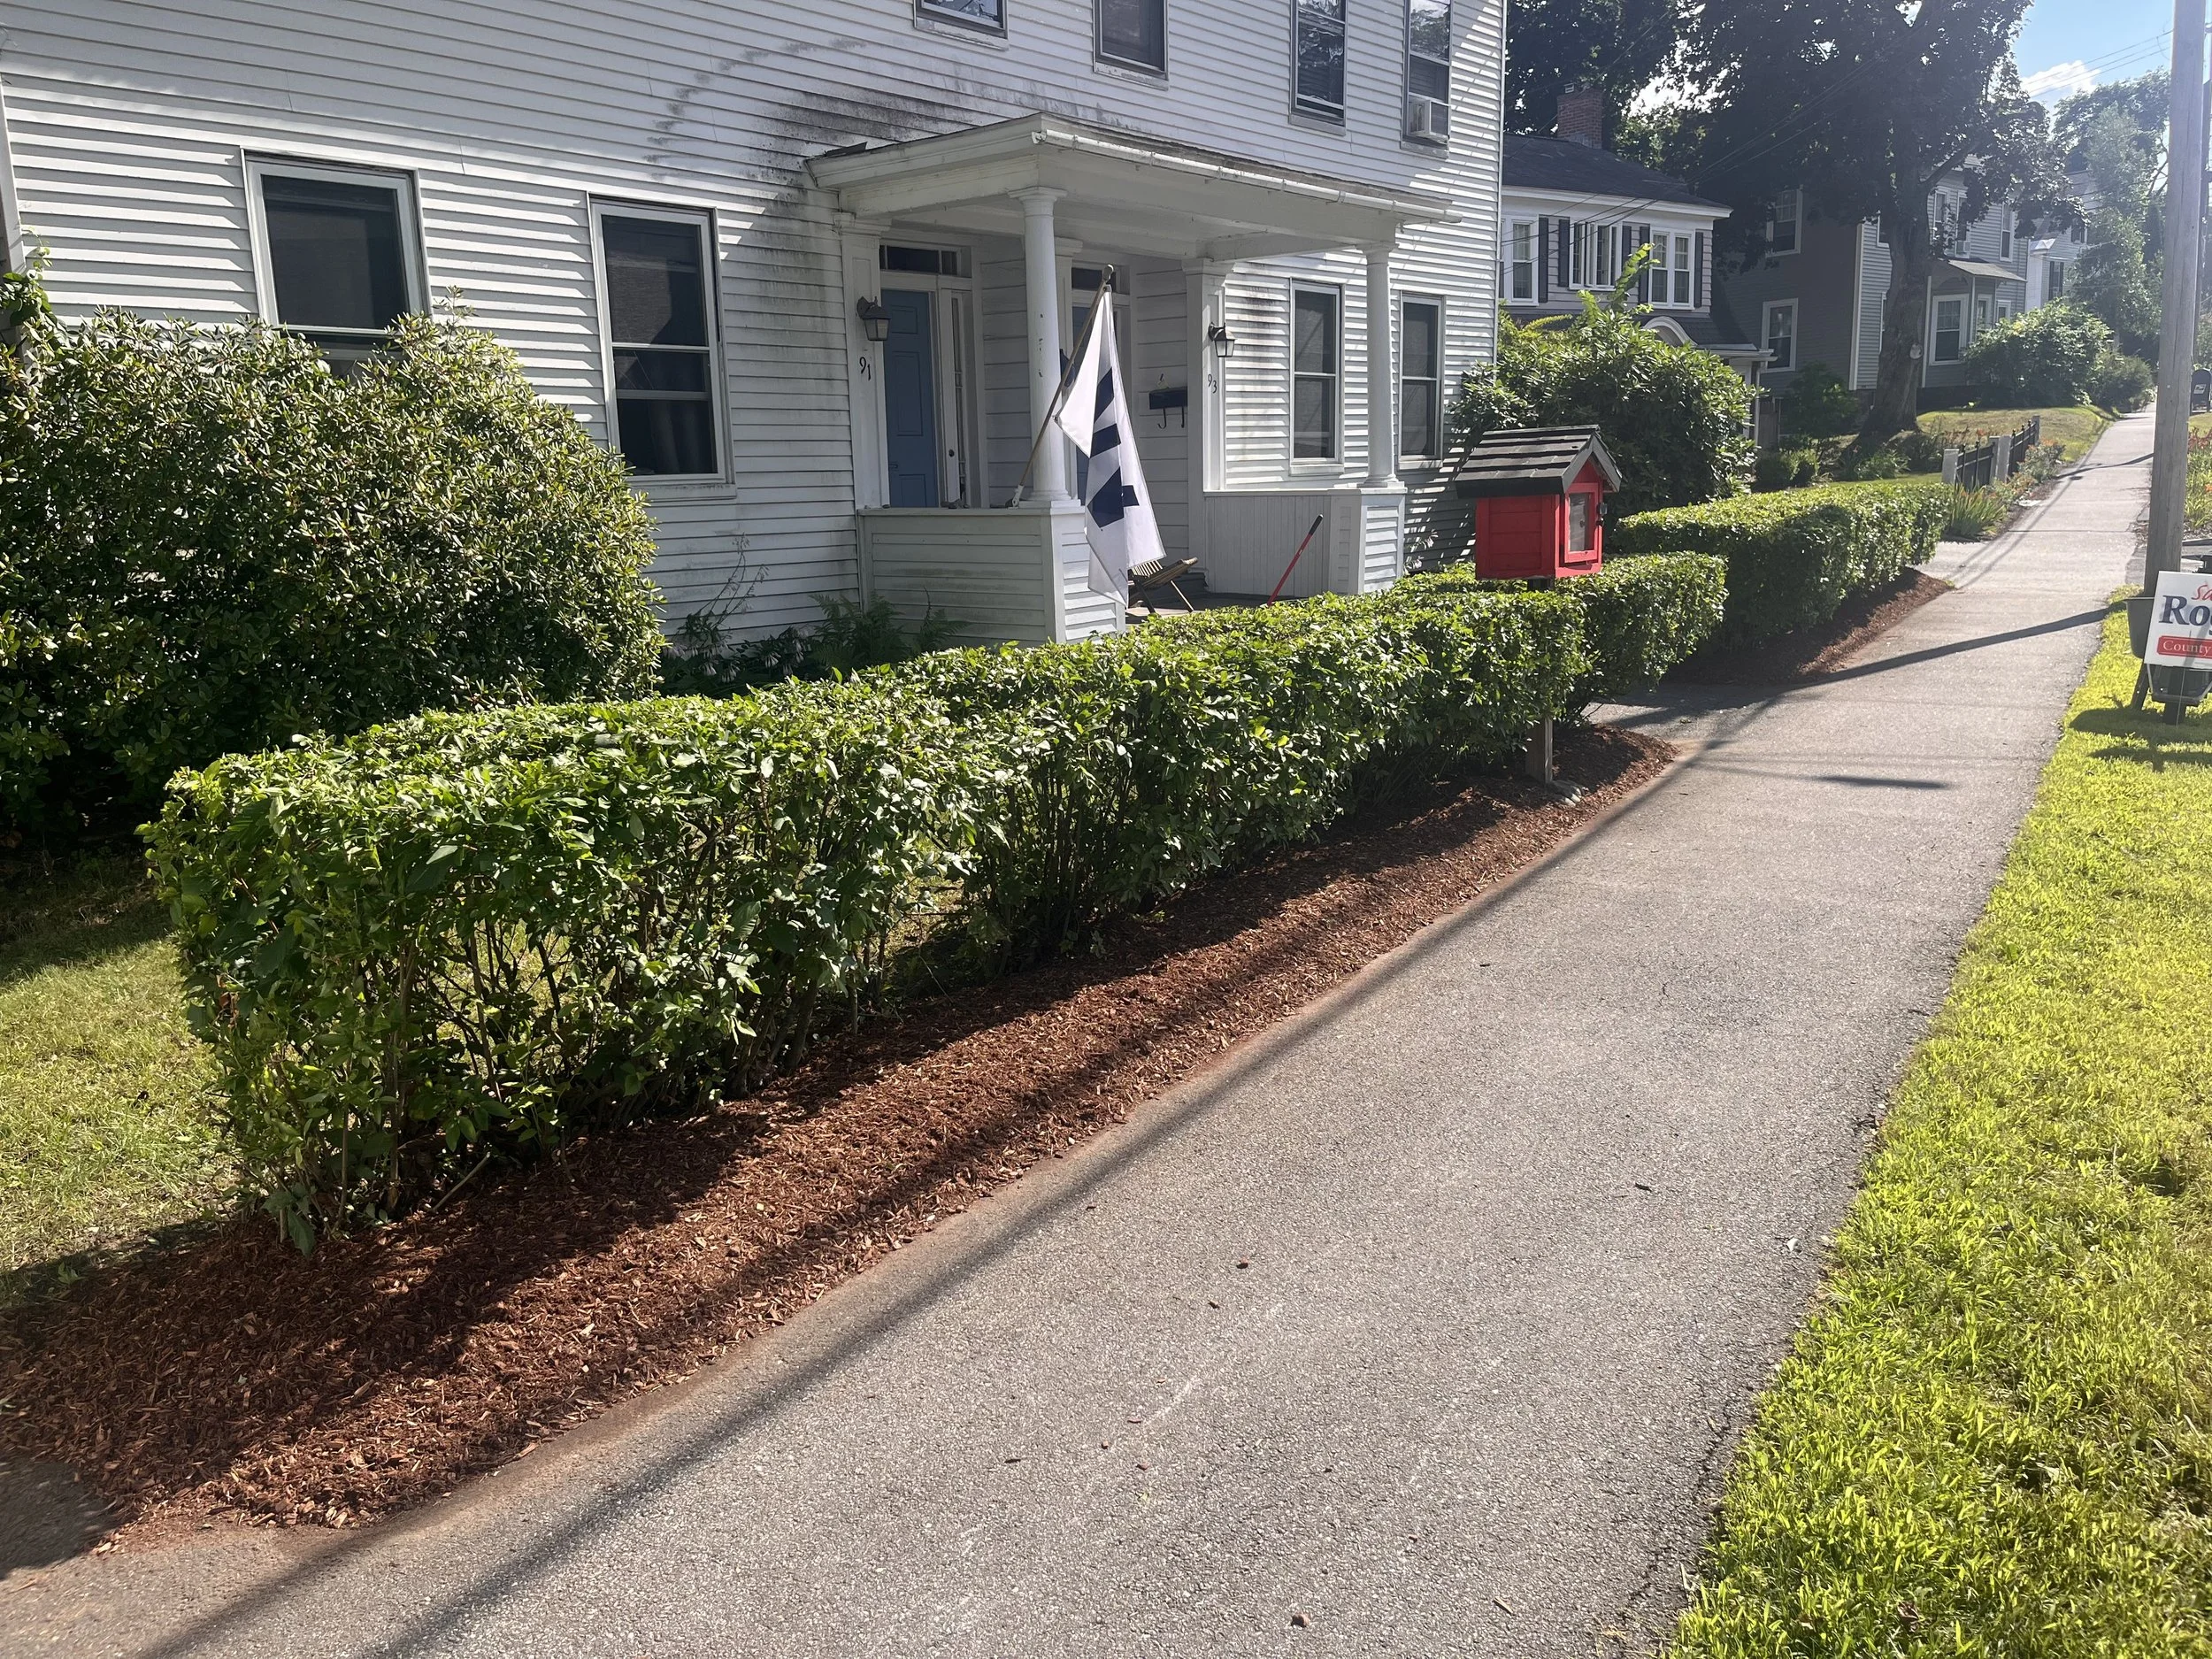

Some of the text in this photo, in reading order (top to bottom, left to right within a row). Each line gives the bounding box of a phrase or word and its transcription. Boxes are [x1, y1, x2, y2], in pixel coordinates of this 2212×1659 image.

[859, 356, 871, 381] 91
[1207, 373, 1217, 394] 93
[2158, 595, 2212, 636] Ro
[2162, 639, 2212, 657] County
